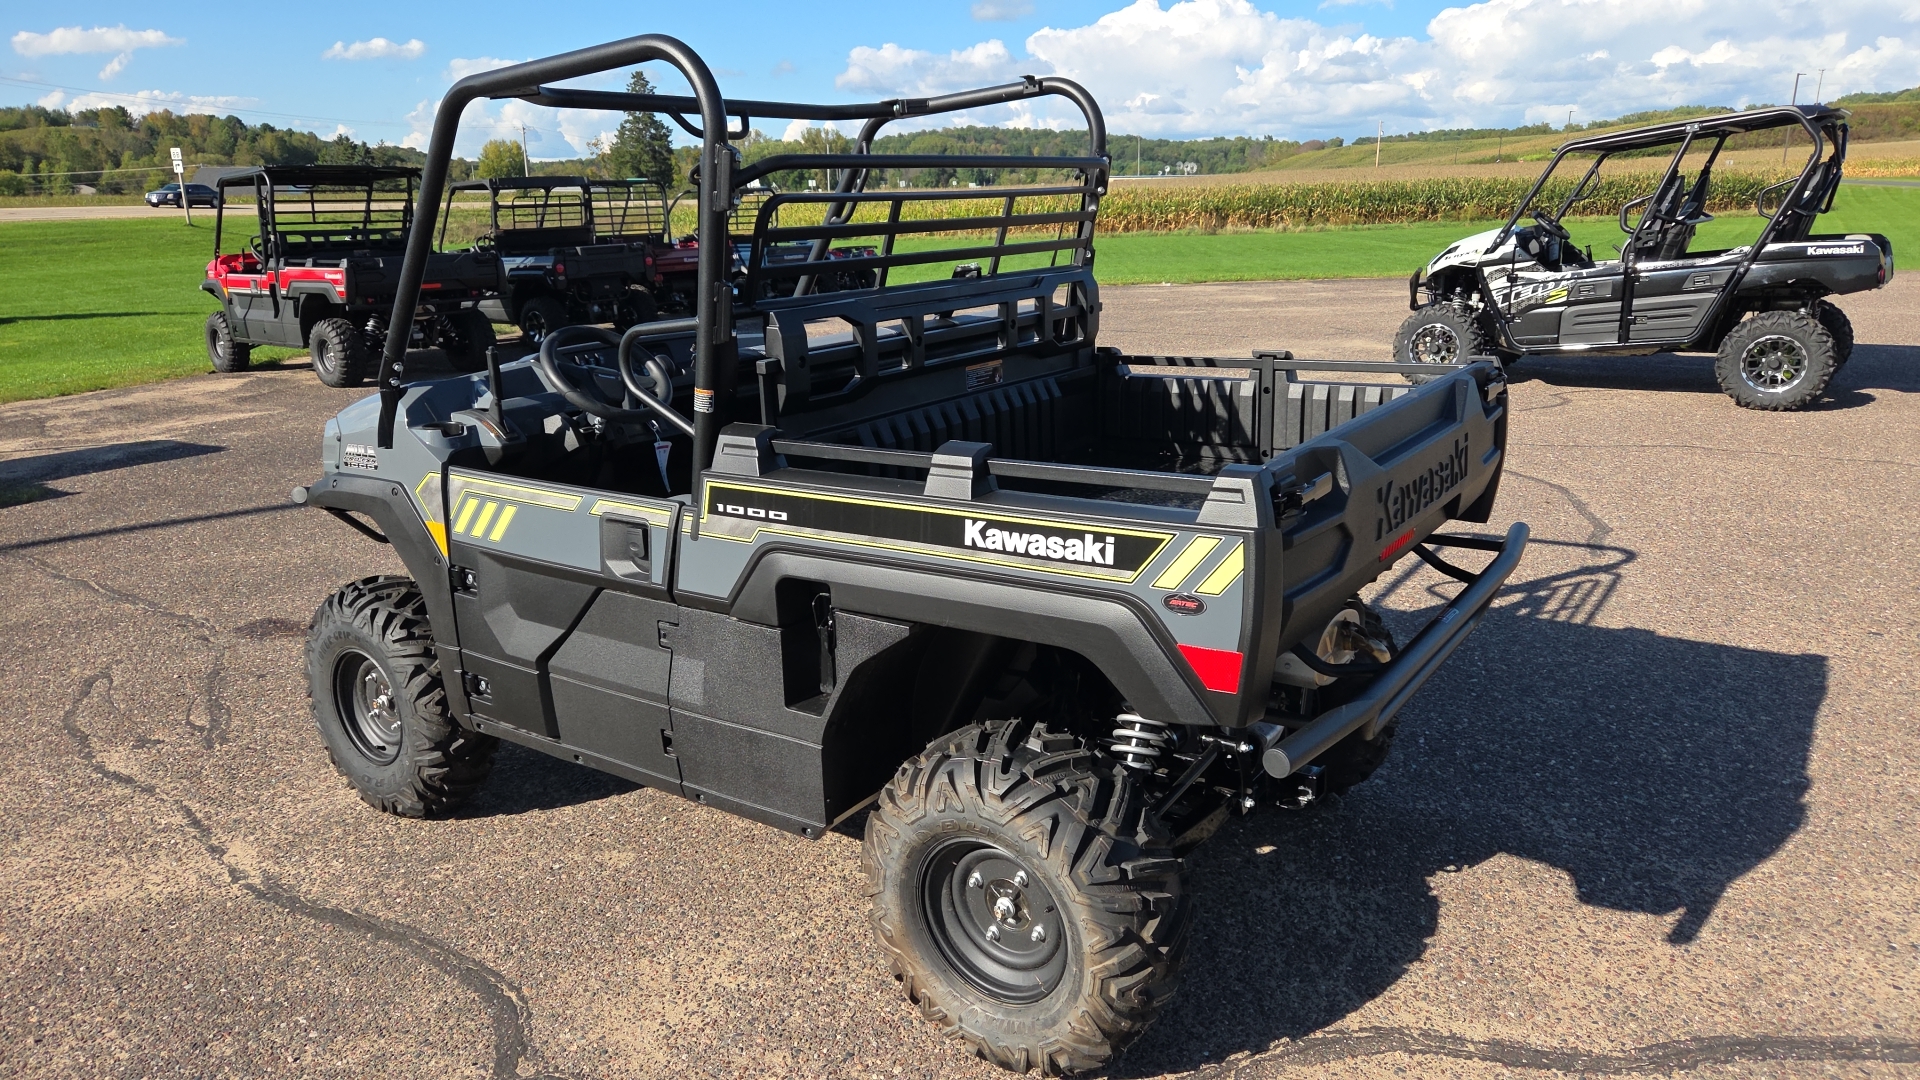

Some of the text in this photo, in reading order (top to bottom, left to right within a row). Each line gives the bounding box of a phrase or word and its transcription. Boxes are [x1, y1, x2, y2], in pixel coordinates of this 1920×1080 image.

[1807, 245, 1864, 255] Kawasaki
[1374, 431, 1469, 542] Kawasaki
[716, 503, 788, 521] 1000
[964, 518, 1115, 566] Kawasaki
